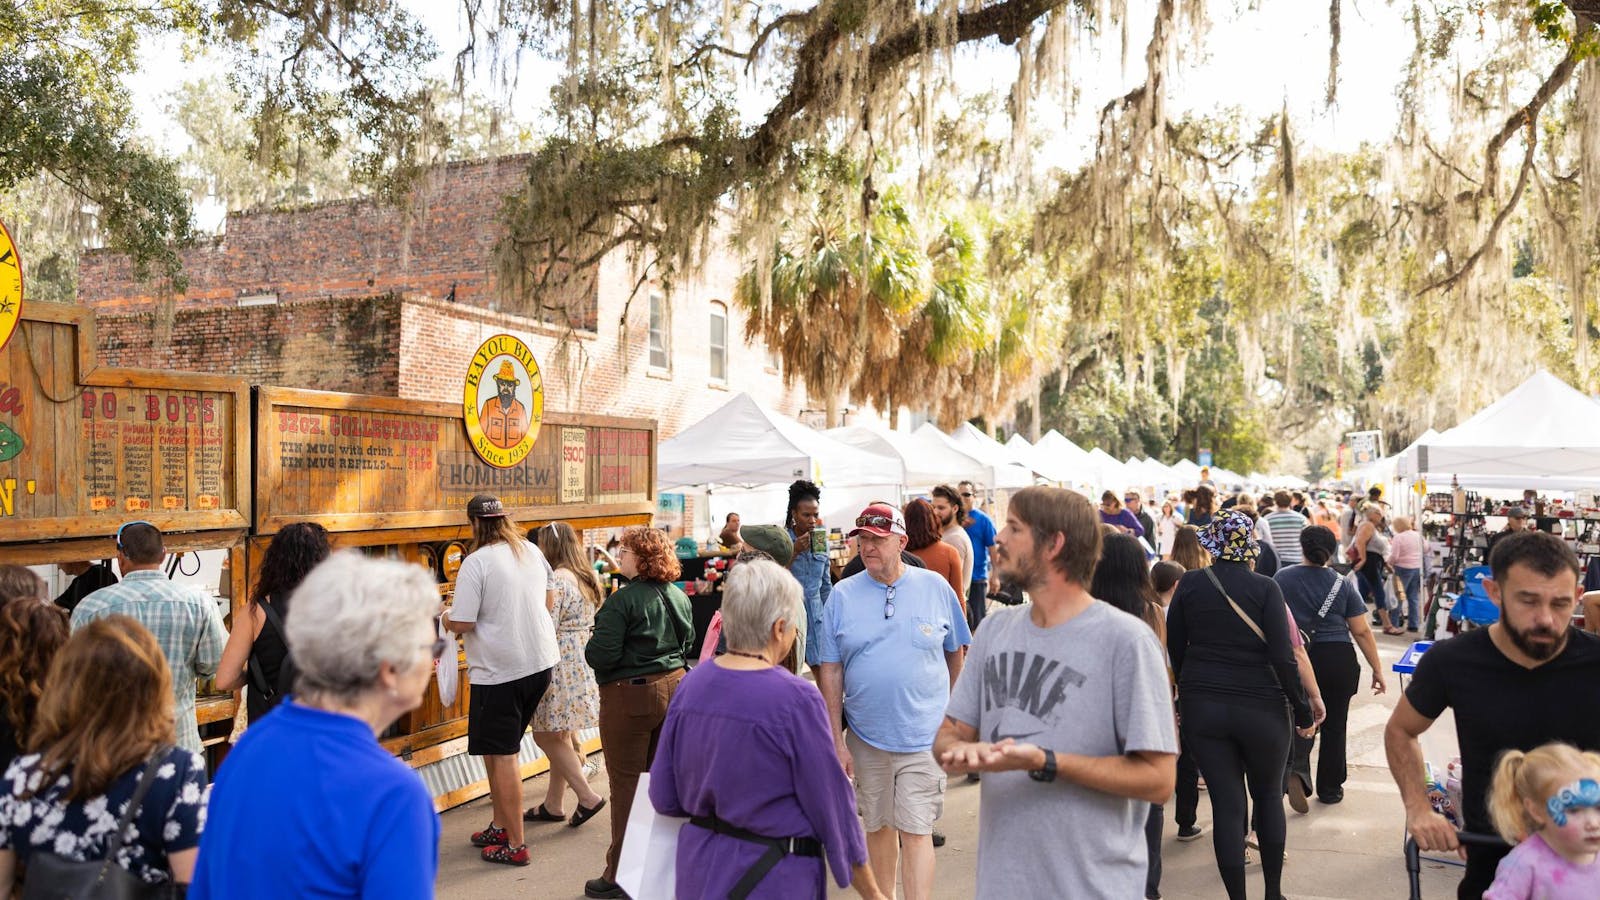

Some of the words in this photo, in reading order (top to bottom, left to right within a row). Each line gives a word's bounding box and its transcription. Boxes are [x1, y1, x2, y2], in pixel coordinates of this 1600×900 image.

[467, 337, 508, 387] BAYOU
[514, 341, 543, 393] BILLY
[330, 414, 438, 441] COLLECTABLE
[280, 441, 302, 453] TIN
[306, 442, 335, 454] MUG
[340, 444, 363, 456] with
[367, 445, 394, 456] drink
[477, 436, 505, 465] Since
[563, 446, 585, 463] $500
[280, 456, 303, 468] TIN
[306, 457, 335, 469] MUG
[449, 463, 551, 488] HOMEBREW
